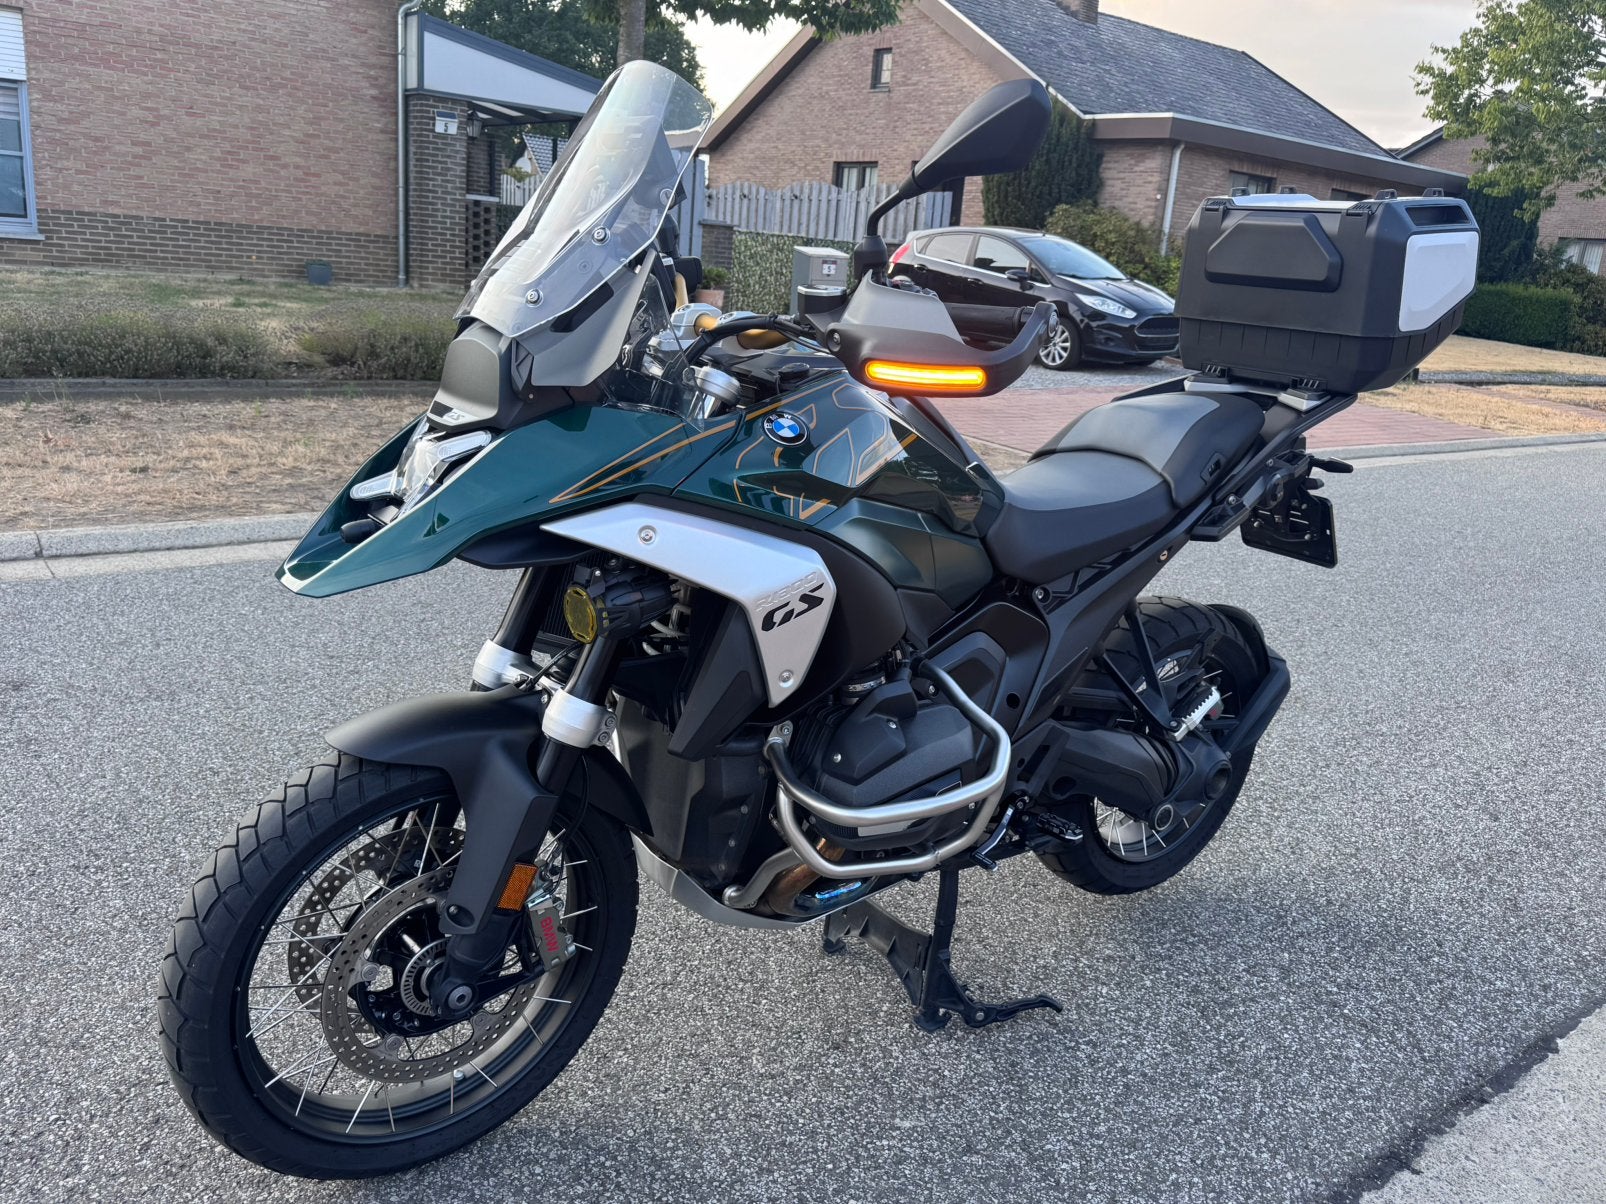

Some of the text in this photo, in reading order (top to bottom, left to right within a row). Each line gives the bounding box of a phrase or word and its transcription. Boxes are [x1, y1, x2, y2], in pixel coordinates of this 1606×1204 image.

[443, 122, 449, 133] 5
[764, 413, 792, 429] BMW
[761, 582, 825, 632] GS
[541, 916, 561, 952] BMW
